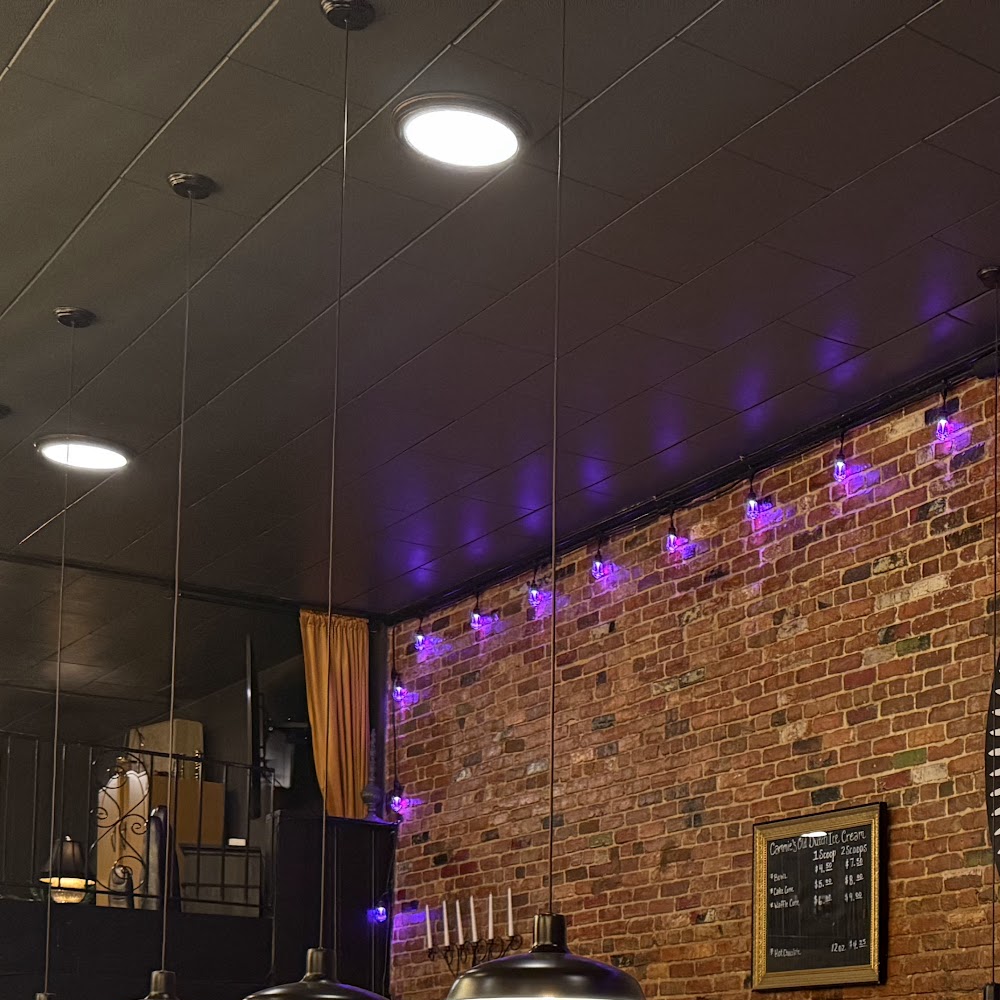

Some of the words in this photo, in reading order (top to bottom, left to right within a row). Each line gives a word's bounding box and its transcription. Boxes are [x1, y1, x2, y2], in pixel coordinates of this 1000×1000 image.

[828, 832, 840, 845] Ice
[841, 830, 866, 843] Cream
[819, 849, 836, 862] Scoop
[846, 844, 867, 857] Scoops
